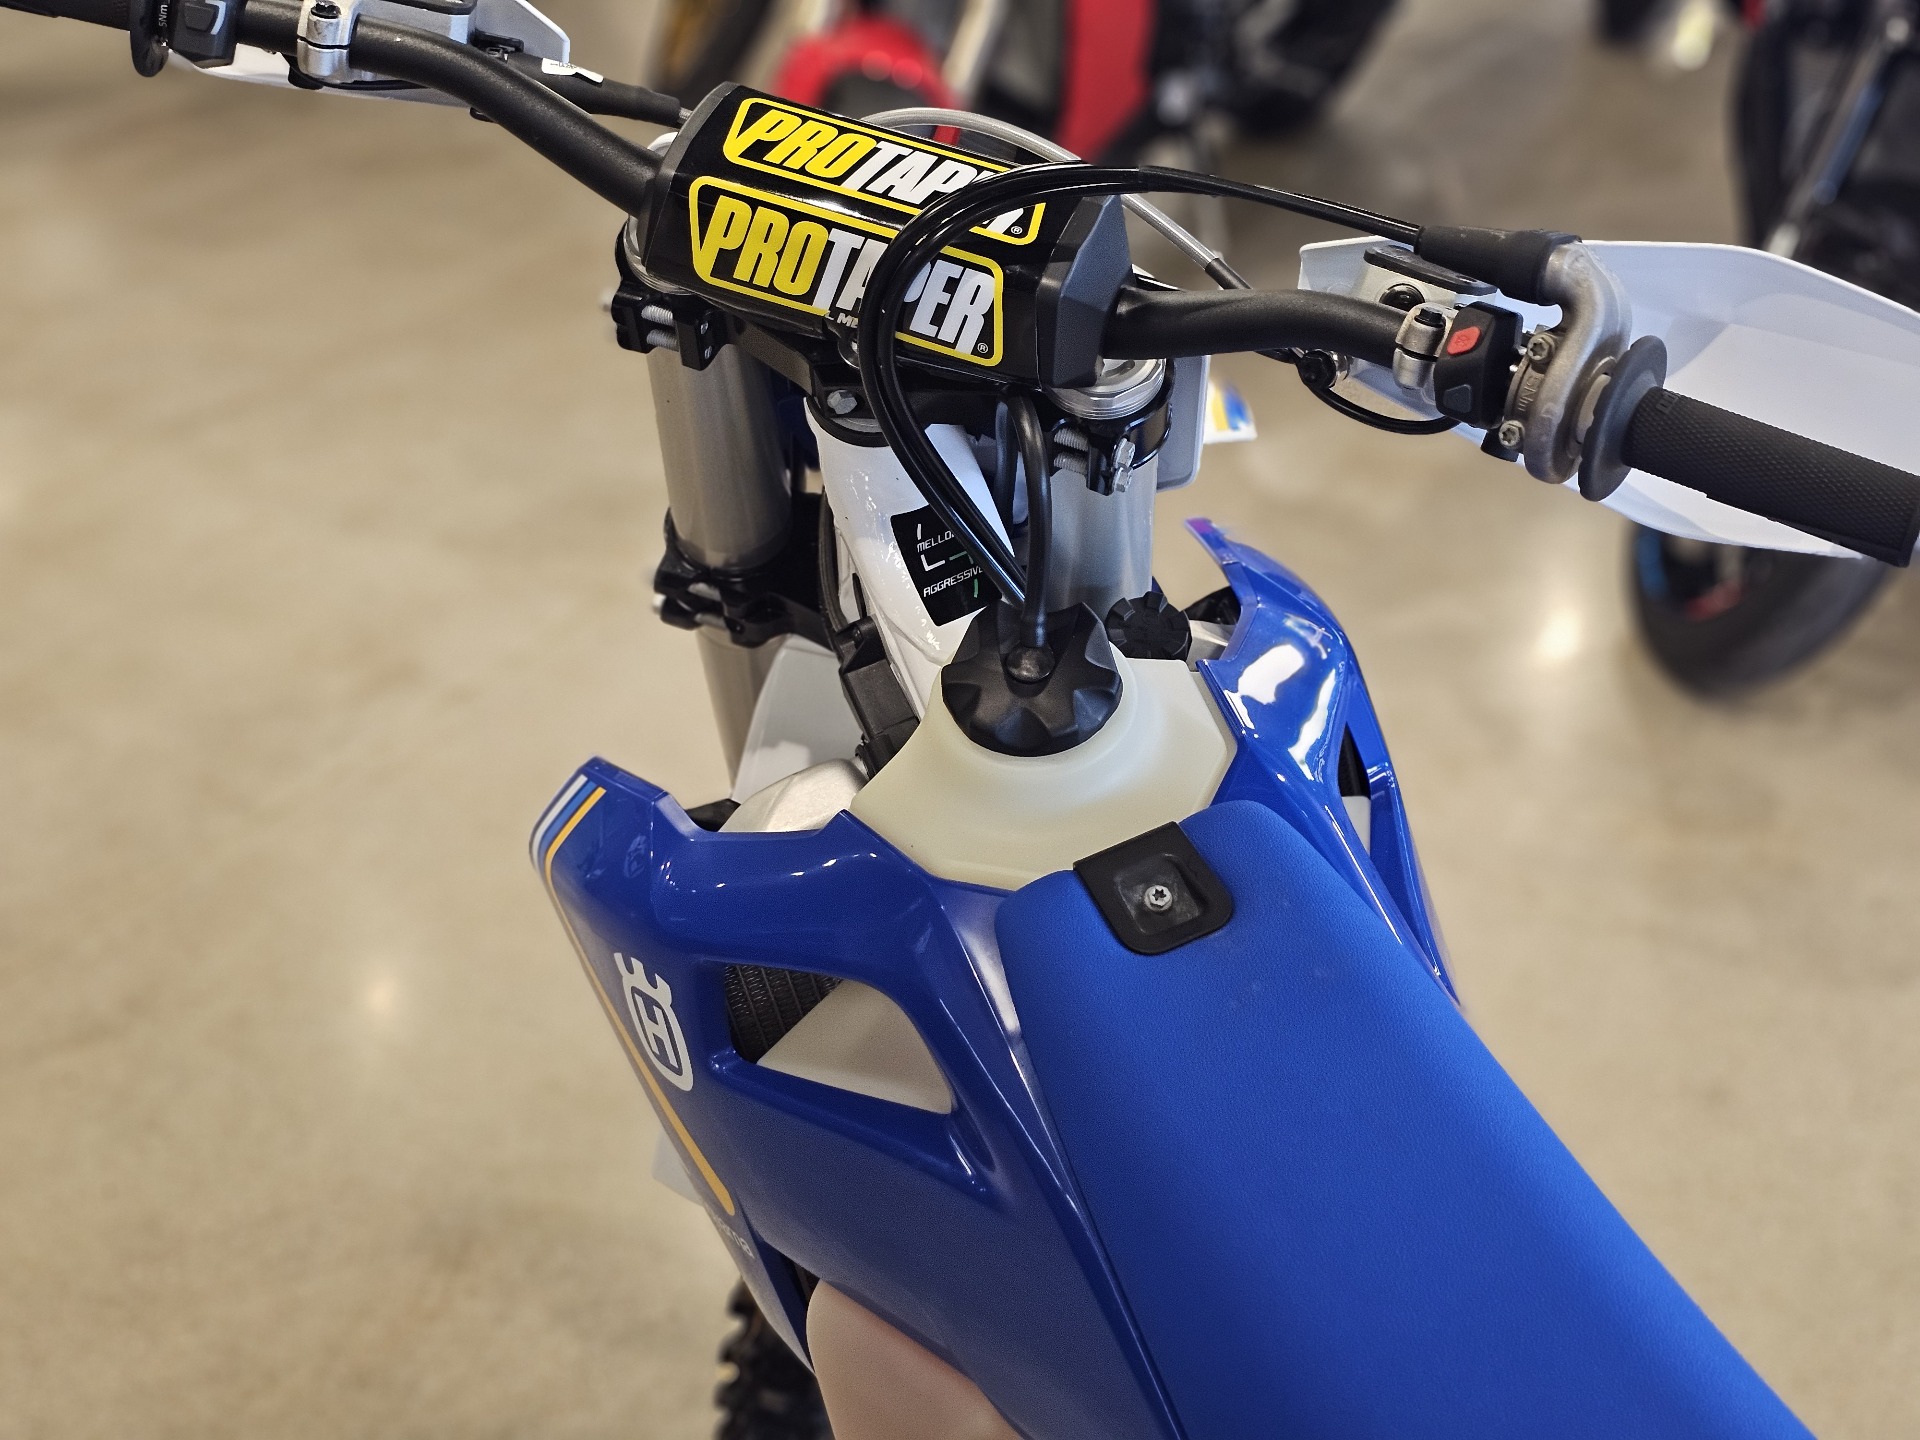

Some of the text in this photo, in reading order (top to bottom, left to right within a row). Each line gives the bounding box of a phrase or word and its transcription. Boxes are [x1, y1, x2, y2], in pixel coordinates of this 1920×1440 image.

[737, 109, 1024, 234] PROTAP
[700, 195, 996, 355] PROTAER
[917, 530, 954, 553] MELLO
